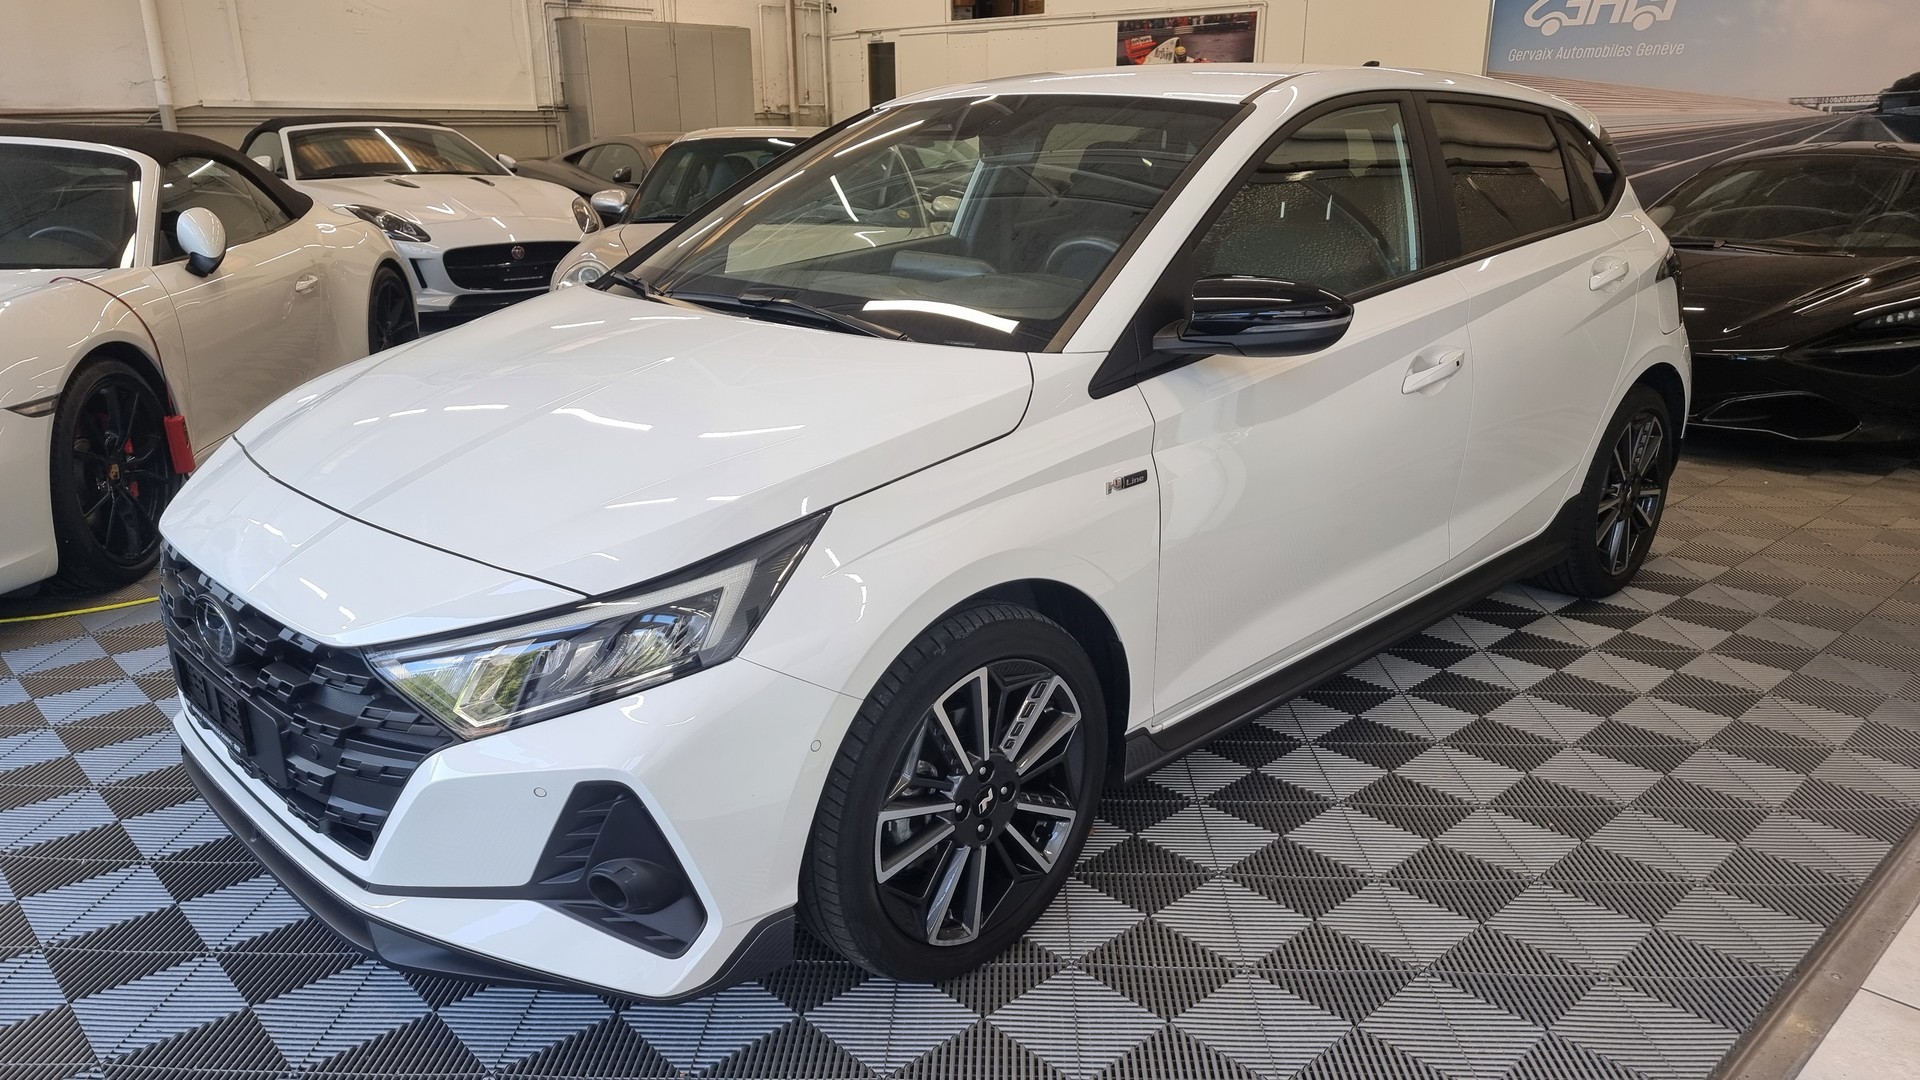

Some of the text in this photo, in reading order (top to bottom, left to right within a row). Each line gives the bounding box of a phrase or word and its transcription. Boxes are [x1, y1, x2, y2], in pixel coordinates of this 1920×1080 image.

[1508, 48, 1554, 61] Gervaix
[1555, 44, 1633, 60] Automobiles
[1126, 475, 1145, 486] Line
